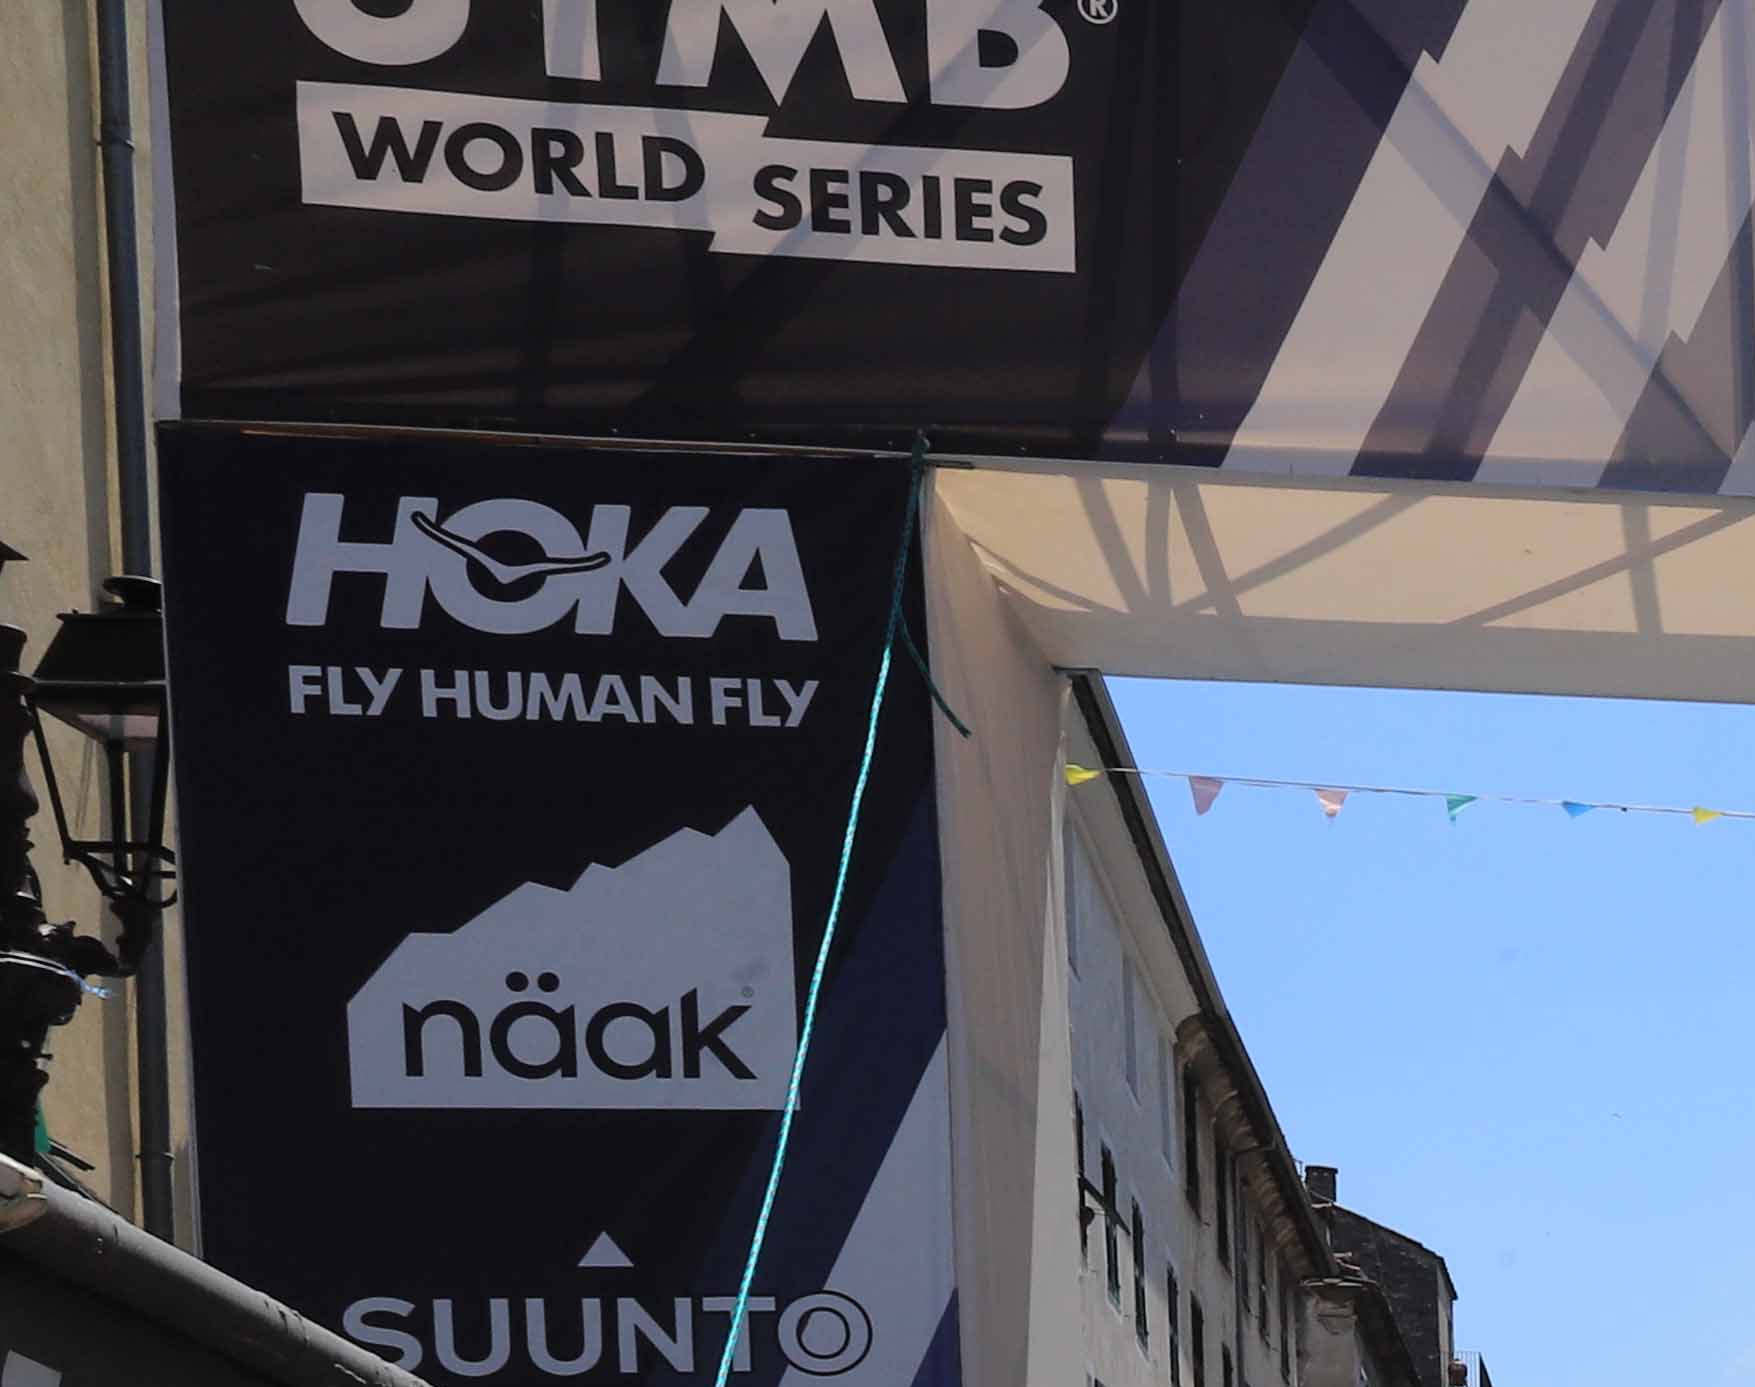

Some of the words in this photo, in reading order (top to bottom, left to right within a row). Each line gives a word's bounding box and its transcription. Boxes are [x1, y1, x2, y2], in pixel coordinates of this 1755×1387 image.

[333, 110, 707, 206] WORLD
[752, 164, 1049, 248] SERIES
[285, 493, 818, 642] HOKA
[288, 665, 403, 719] FLY
[419, 671, 695, 726] HUMAN
[710, 678, 819, 729] FLY
[400, 971, 759, 1082] näak
[342, 1289, 874, 1376] SUUNTO
